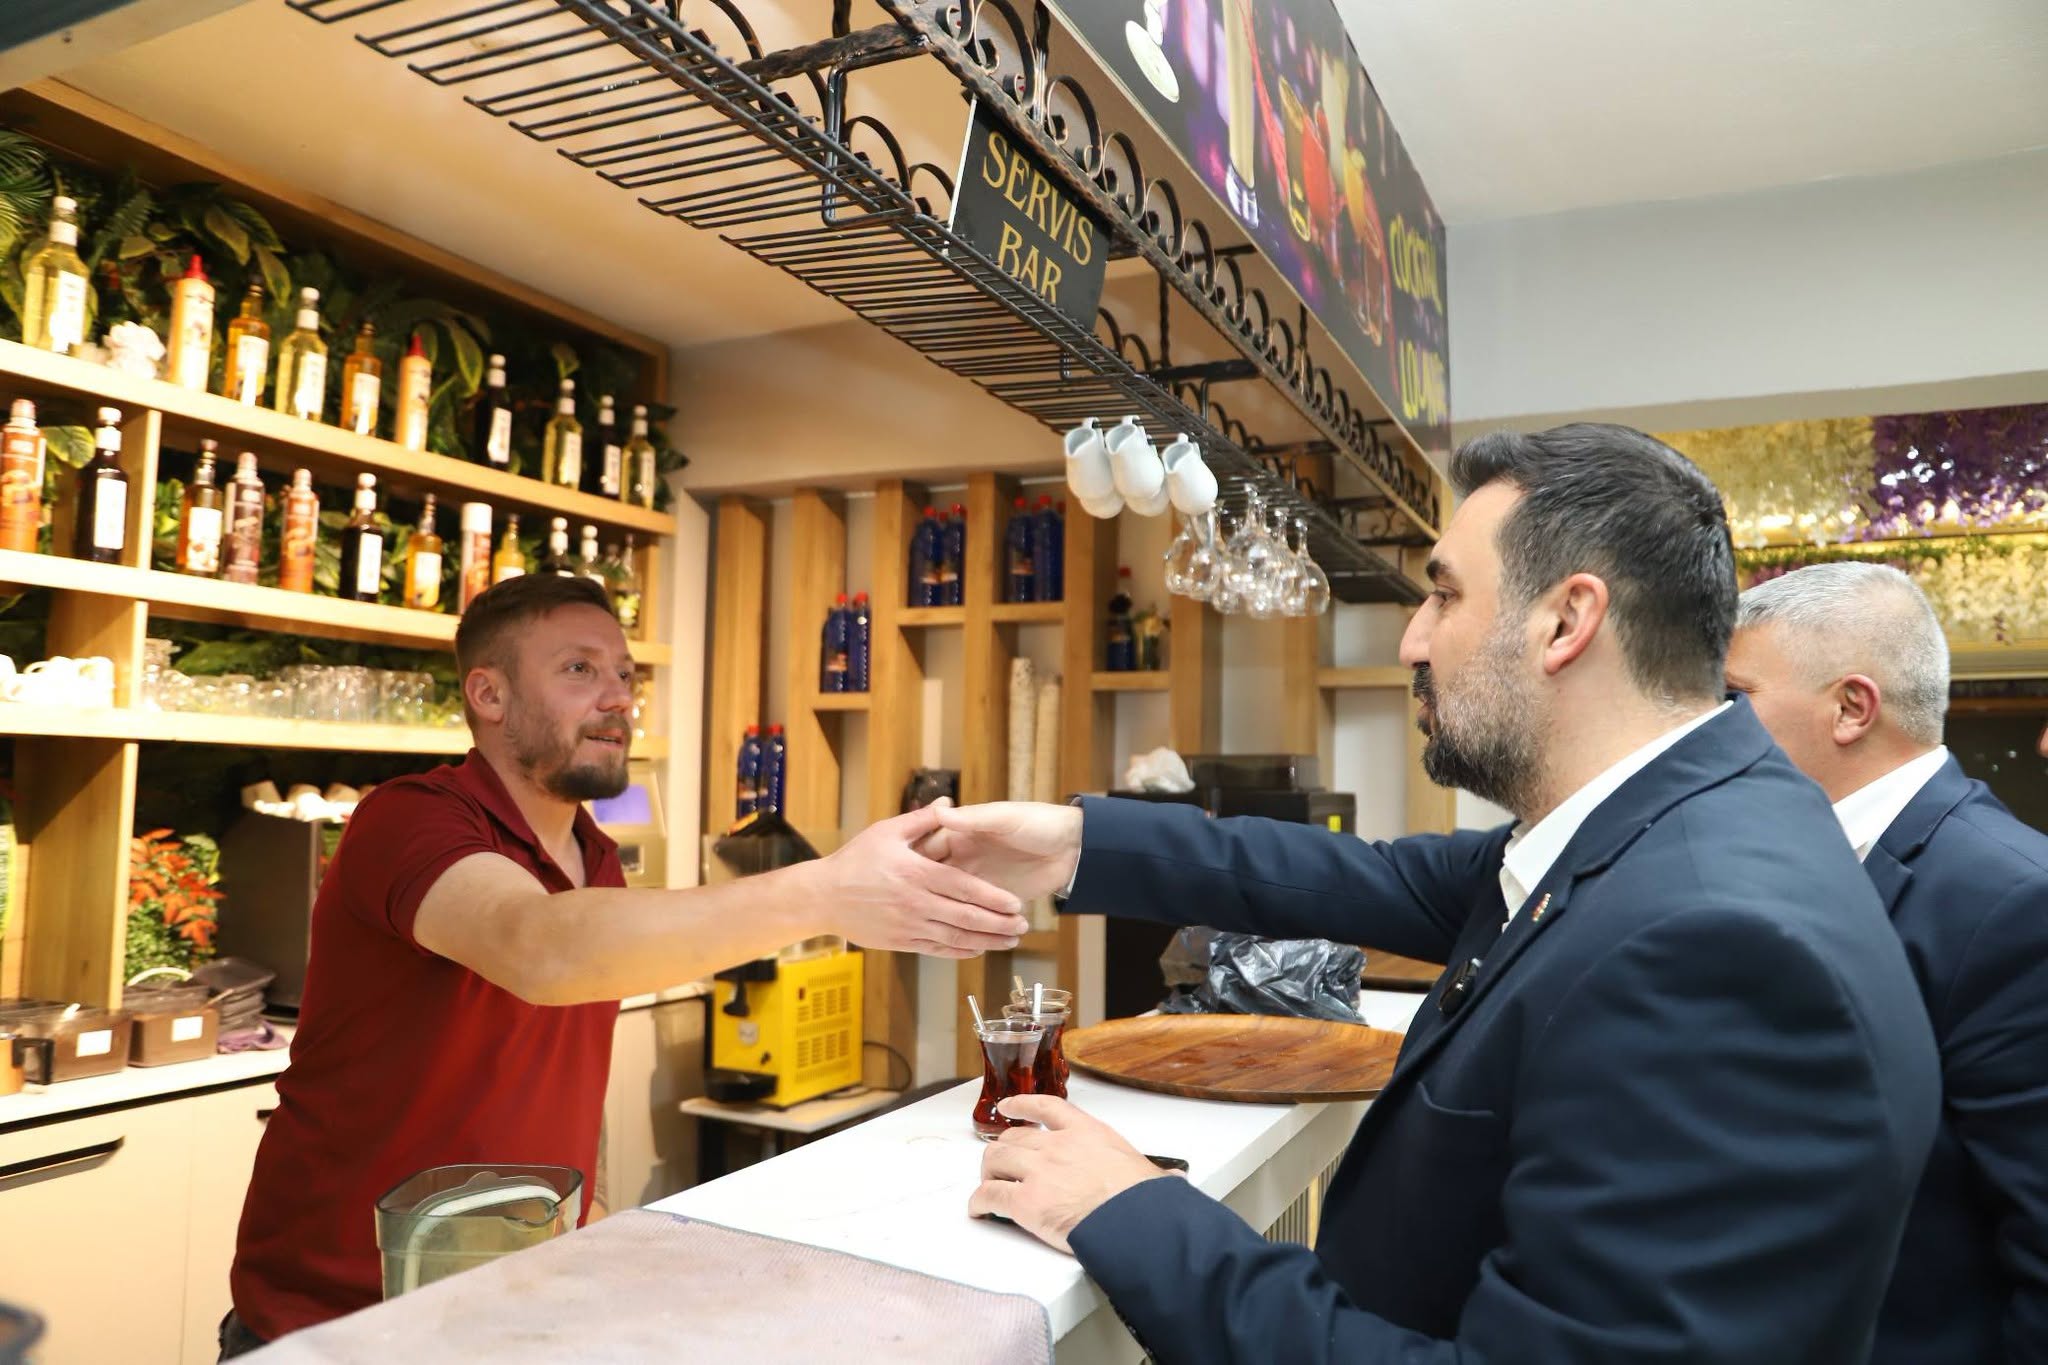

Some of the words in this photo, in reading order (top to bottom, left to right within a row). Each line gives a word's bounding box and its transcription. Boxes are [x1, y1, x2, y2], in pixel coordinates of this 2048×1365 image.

[982, 131, 1094, 266] SERVIS
[998, 220, 1062, 308] BAR
[1400, 338, 1448, 427] LOU
